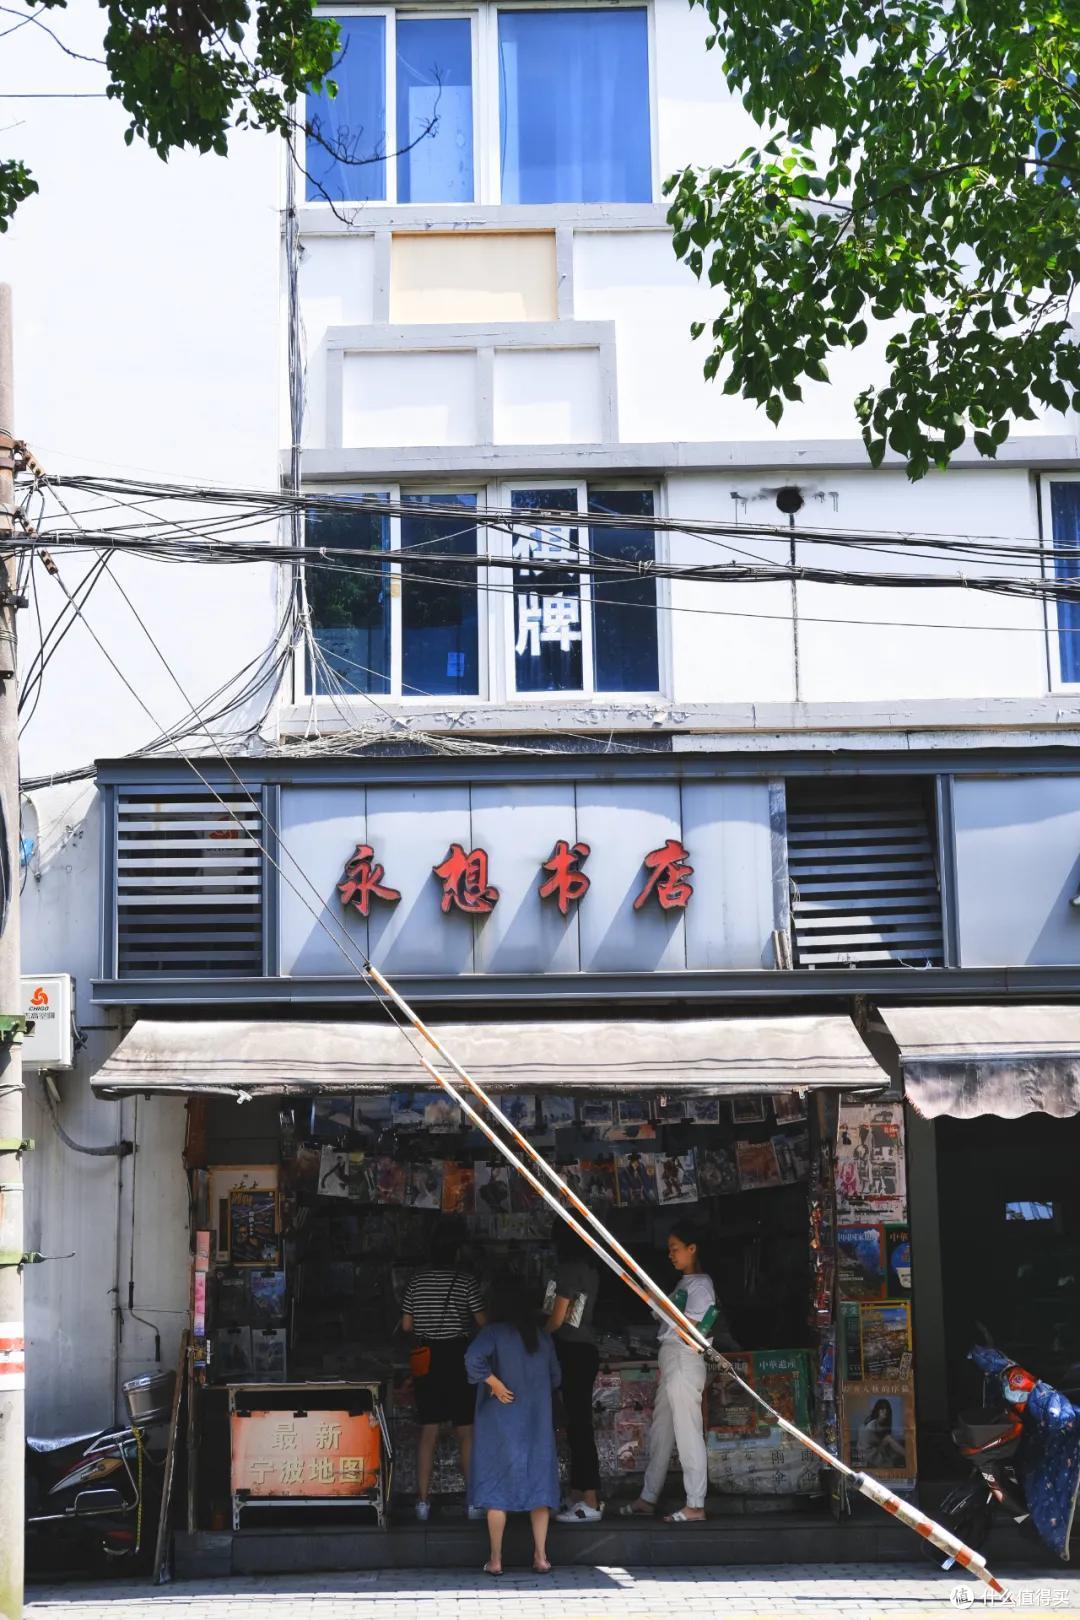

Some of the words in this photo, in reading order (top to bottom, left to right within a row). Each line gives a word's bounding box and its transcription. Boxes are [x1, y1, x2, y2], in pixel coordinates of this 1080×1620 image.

[336, 838, 695, 917] 永想书店
[272, 1421, 343, 1450] 最新
[250, 1456, 364, 1485] 宁波地图
